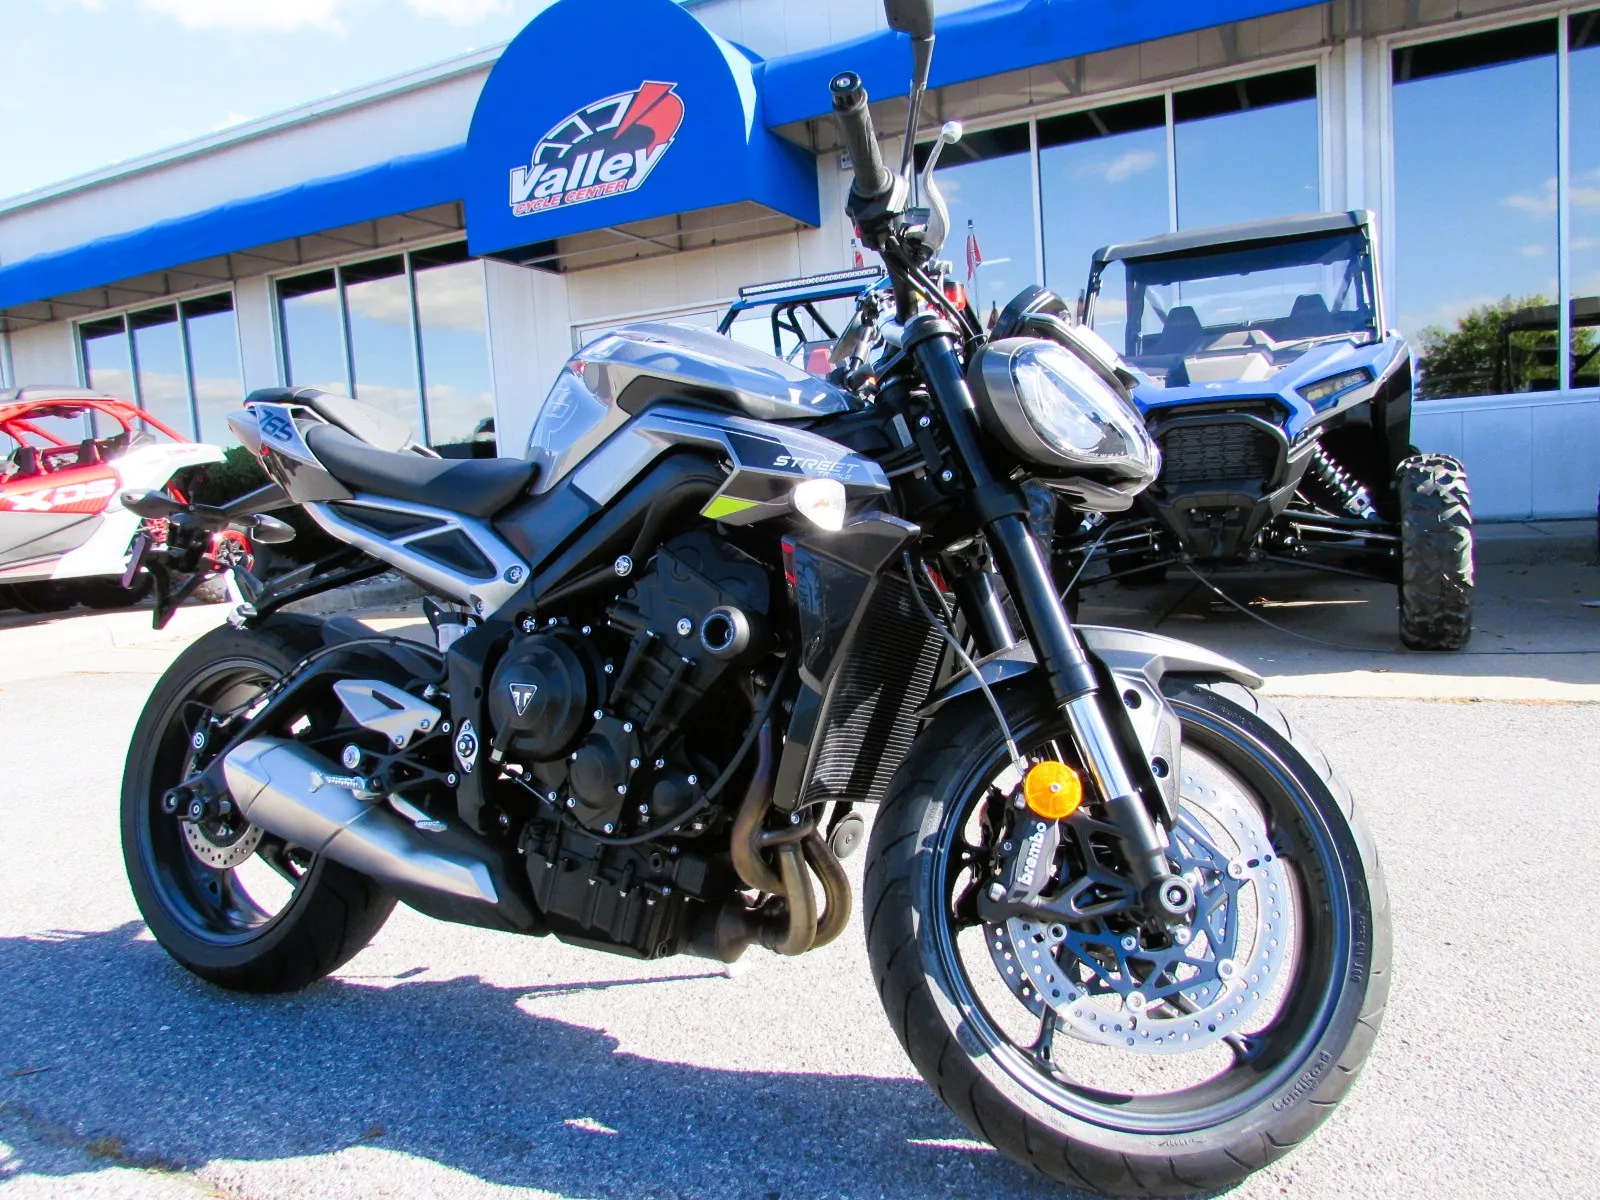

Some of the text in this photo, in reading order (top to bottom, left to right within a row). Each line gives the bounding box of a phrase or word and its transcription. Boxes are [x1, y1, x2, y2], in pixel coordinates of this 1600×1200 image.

[511, 144, 668, 203] Valley
[515, 180, 627, 214] CYCLE CENTER
[258, 409, 293, 442] 765
[773, 456, 860, 473] STREET
[1017, 822, 1047, 886] brembo
